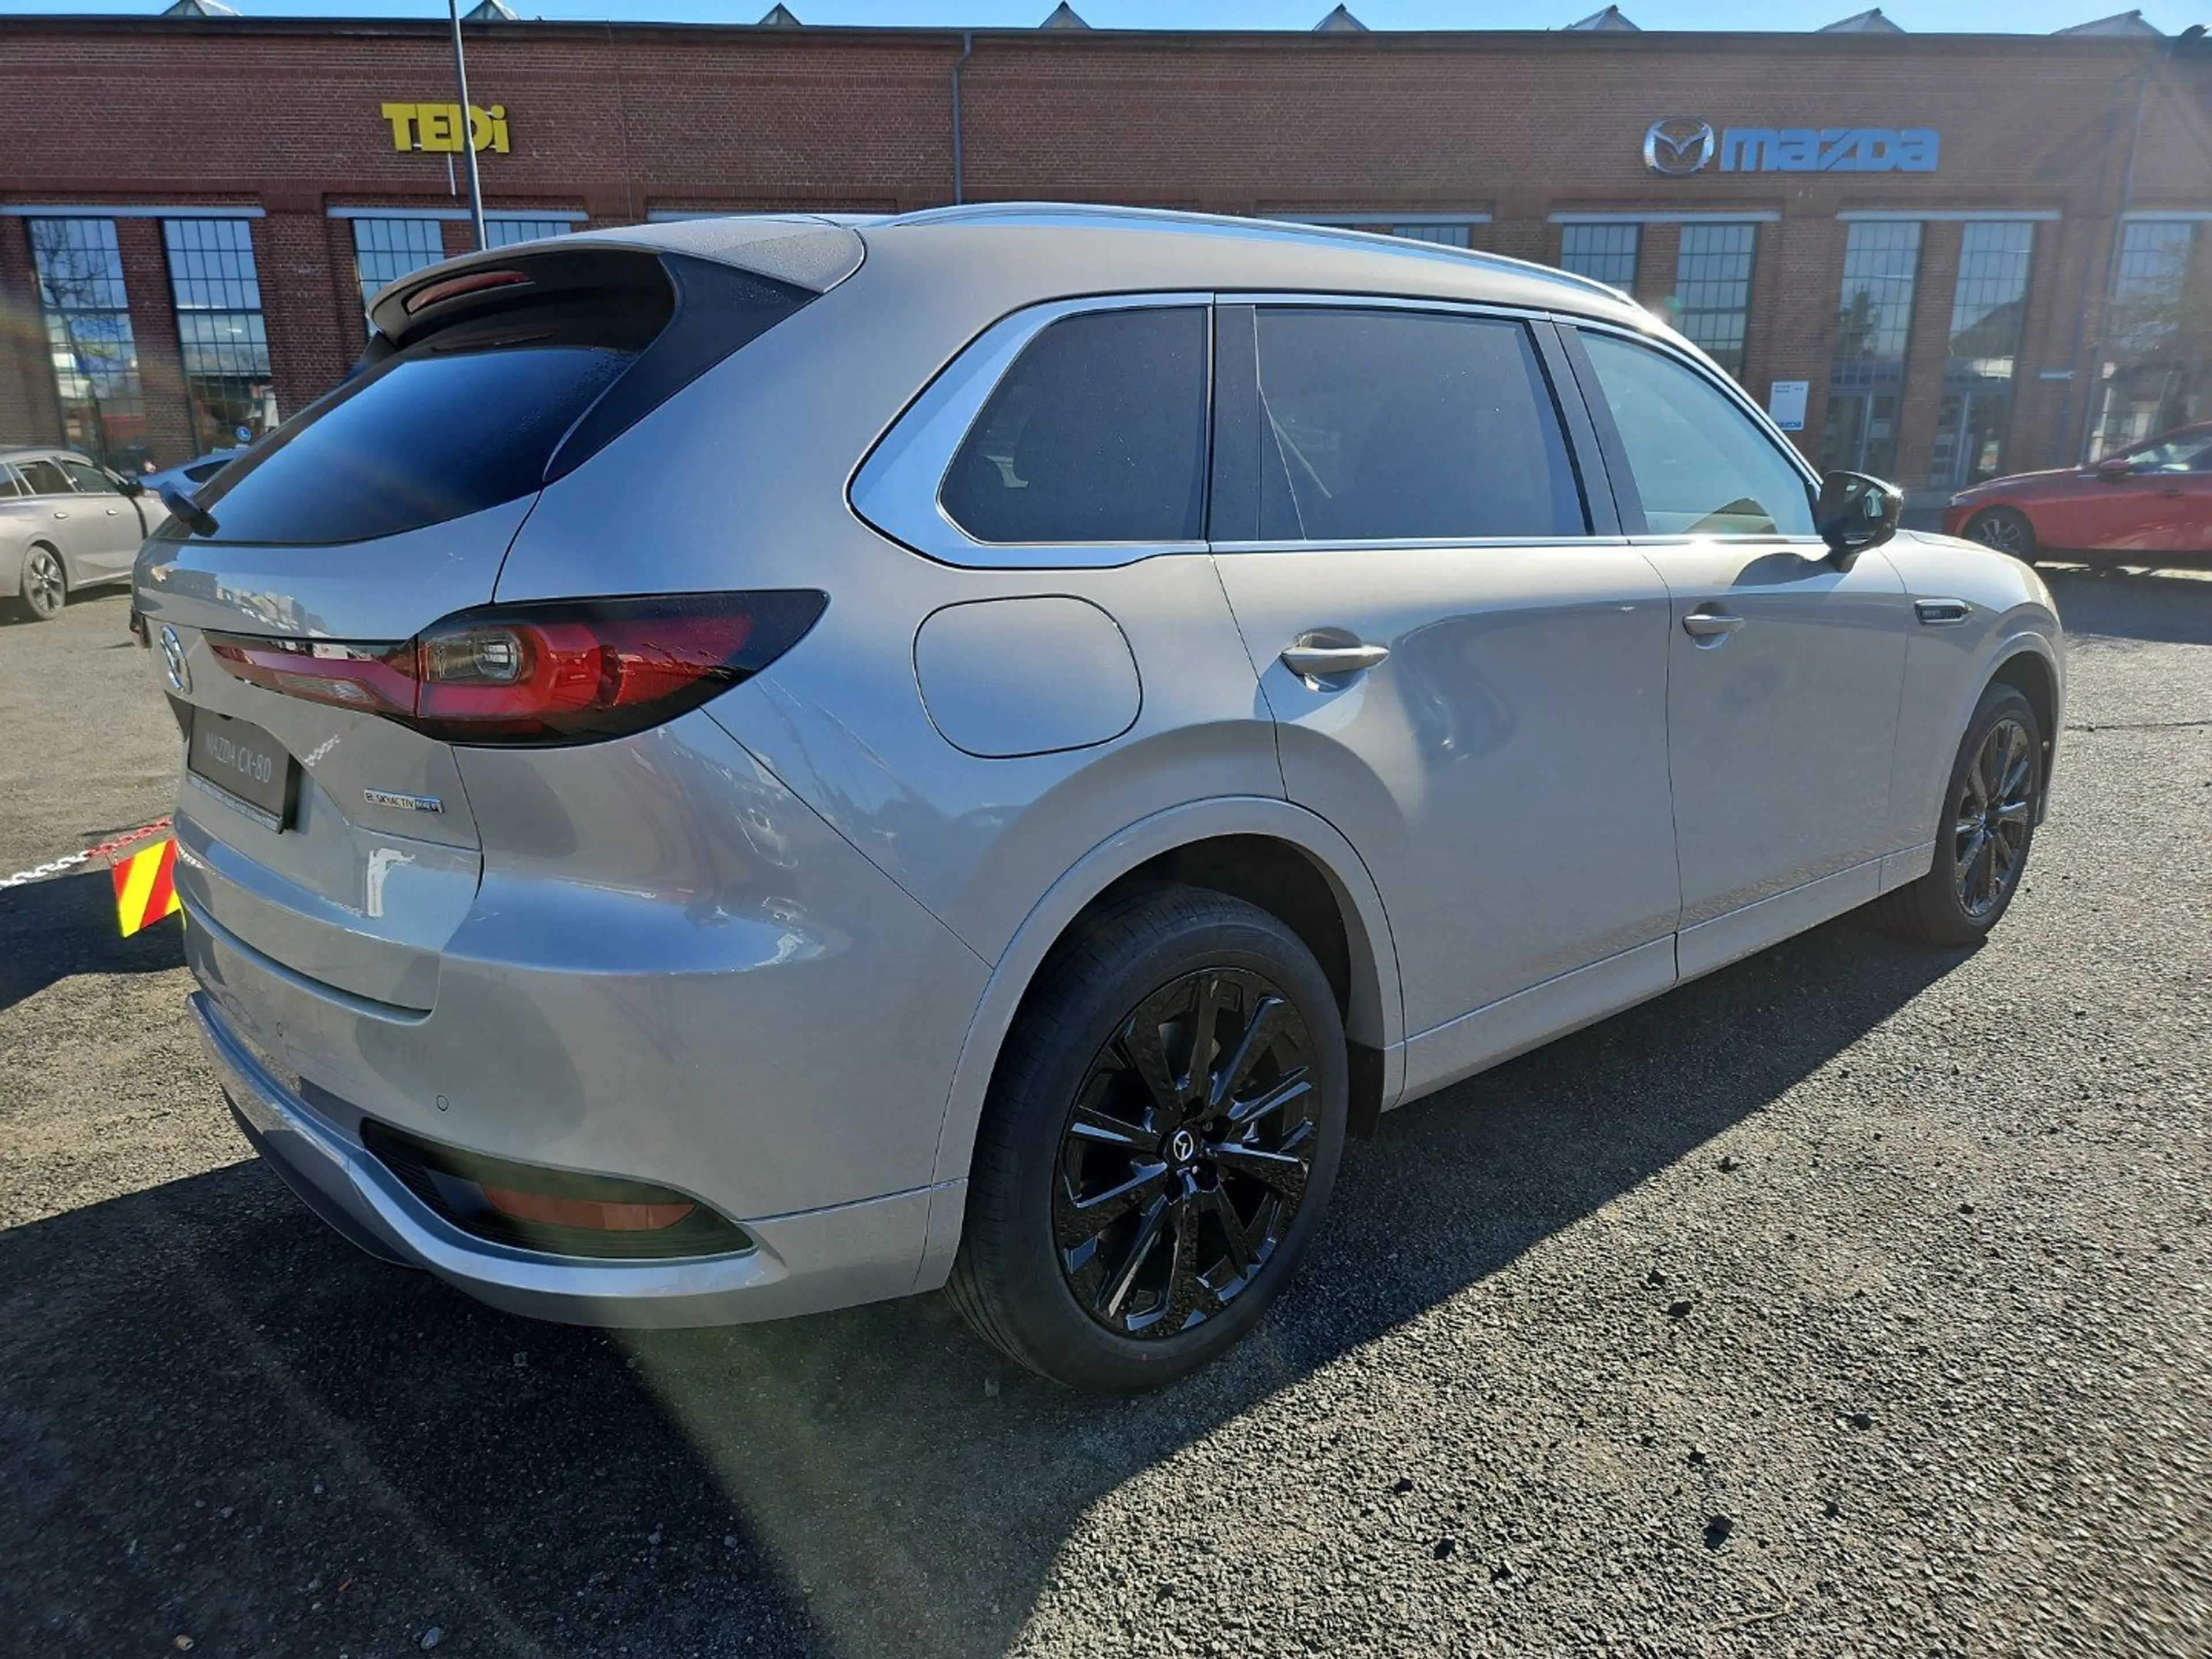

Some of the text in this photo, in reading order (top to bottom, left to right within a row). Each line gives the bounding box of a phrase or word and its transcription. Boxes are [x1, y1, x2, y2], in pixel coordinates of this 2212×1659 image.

[381, 103, 509, 153] TEDi
[1720, 127, 1940, 172] mazda
[206, 731, 272, 783] MAZDA CX-80
